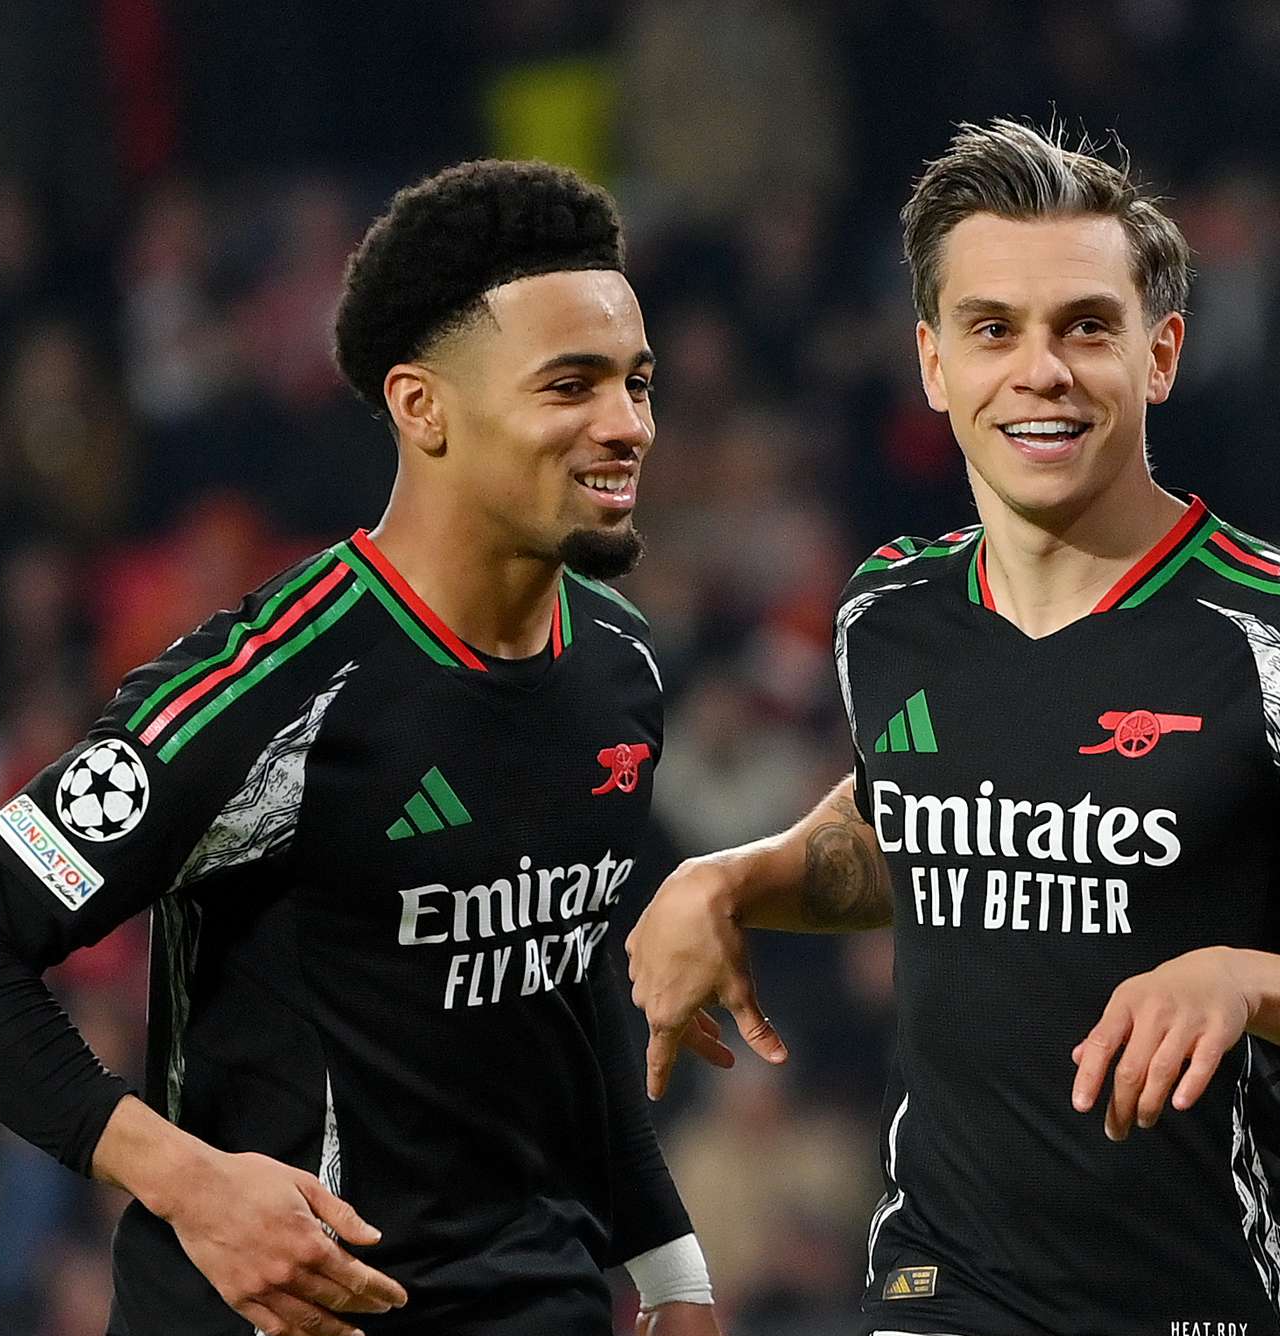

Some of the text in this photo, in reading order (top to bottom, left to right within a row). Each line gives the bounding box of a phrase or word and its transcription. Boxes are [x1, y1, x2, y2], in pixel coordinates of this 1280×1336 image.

[3, 803, 92, 898] FOUNDATION
[872, 780, 1181, 867] Emirates
[397, 848, 637, 946] Emirate
[911, 866, 1132, 934] FLY BETTER
[443, 946, 512, 1010] FLY
